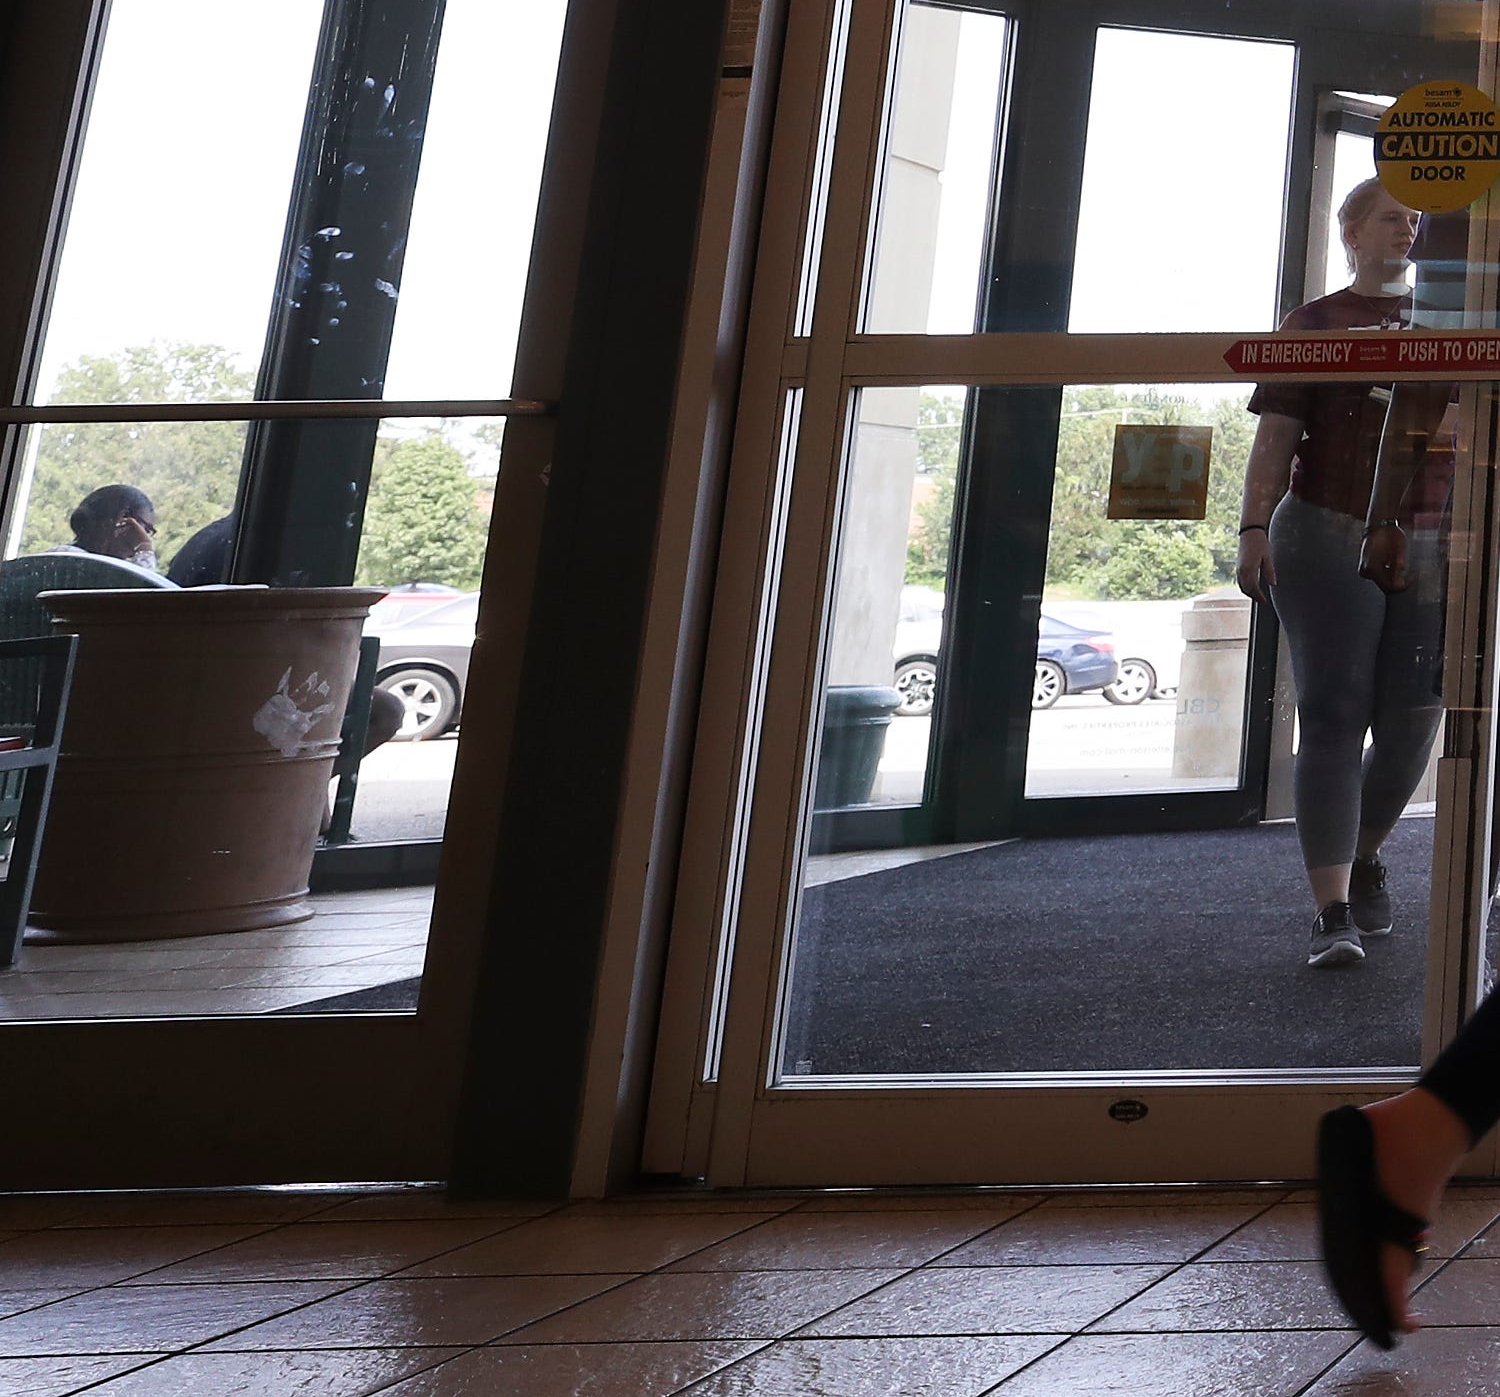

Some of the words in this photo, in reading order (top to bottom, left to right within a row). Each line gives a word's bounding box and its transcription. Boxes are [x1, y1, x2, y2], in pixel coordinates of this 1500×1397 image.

[1388, 111, 1495, 128] AUTOMATIC
[1381, 134, 1499, 157] CAUTION
[1410, 165, 1466, 181] DOOR
[1241, 342, 1259, 364] IN
[1260, 342, 1353, 364] EMERGENCY
[1398, 341, 1438, 362] PUSH
[1443, 341, 1462, 361] TO
